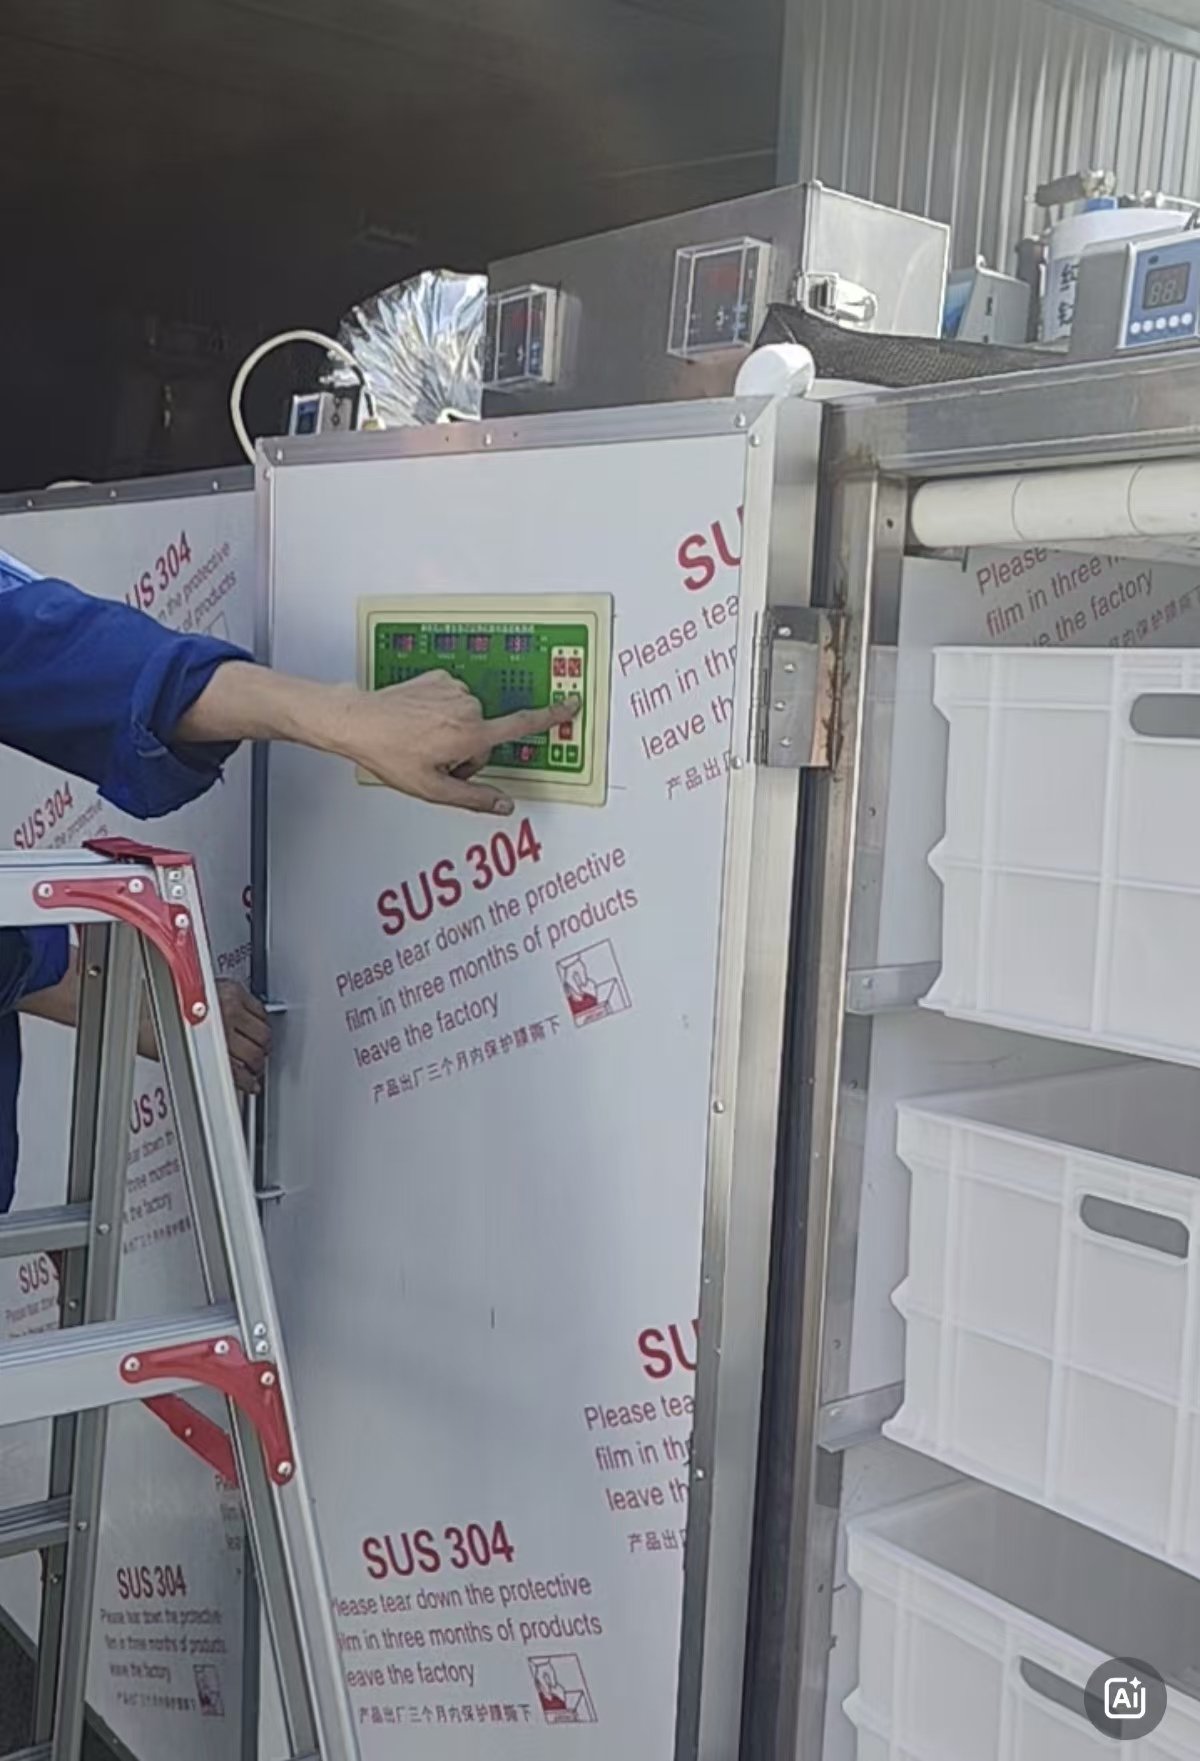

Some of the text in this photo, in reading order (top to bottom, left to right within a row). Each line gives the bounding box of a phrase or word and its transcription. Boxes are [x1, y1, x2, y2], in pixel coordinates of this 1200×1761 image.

[155, 530, 192, 591] 304
[985, 602, 1026, 639] film
[1027, 588, 1049, 613] in
[1051, 556, 1102, 599] three
[1055, 569, 1154, 643] the factory
[618, 619, 699, 678] Please
[630, 682, 673, 719] film
[677, 668, 700, 696] in
[642, 713, 706, 760] leave
[45, 780, 74, 828] 304
[377, 817, 543, 936] SUS 304
[335, 847, 627, 998] Please tear down the protective
[344, 887, 640, 1033] film in three months of products
[353, 991, 500, 1068] leave the factory
[19, 1256, 50, 1295] SUS
[584, 1401, 657, 1431] Please
[595, 1446, 635, 1472] film
[638, 1441, 656, 1465] in
[606, 1490, 664, 1512] leave
[362, 1520, 514, 1580] SUS 304
[117, 1563, 187, 1600] SUS 304
[380, 1589, 412, 1613] tear
[417, 1587, 463, 1611] down
[465, 1582, 496, 1606] the
[499, 1573, 592, 1608] protective
[365, 1628, 381, 1650] in
[382, 1621, 426, 1648] three
[429, 1620, 494, 1647] months
[498, 1617, 517, 1641] of
[520, 1613, 603, 1645] products
[387, 1664, 415, 1685] the
[416, 1660, 475, 1688] factory
